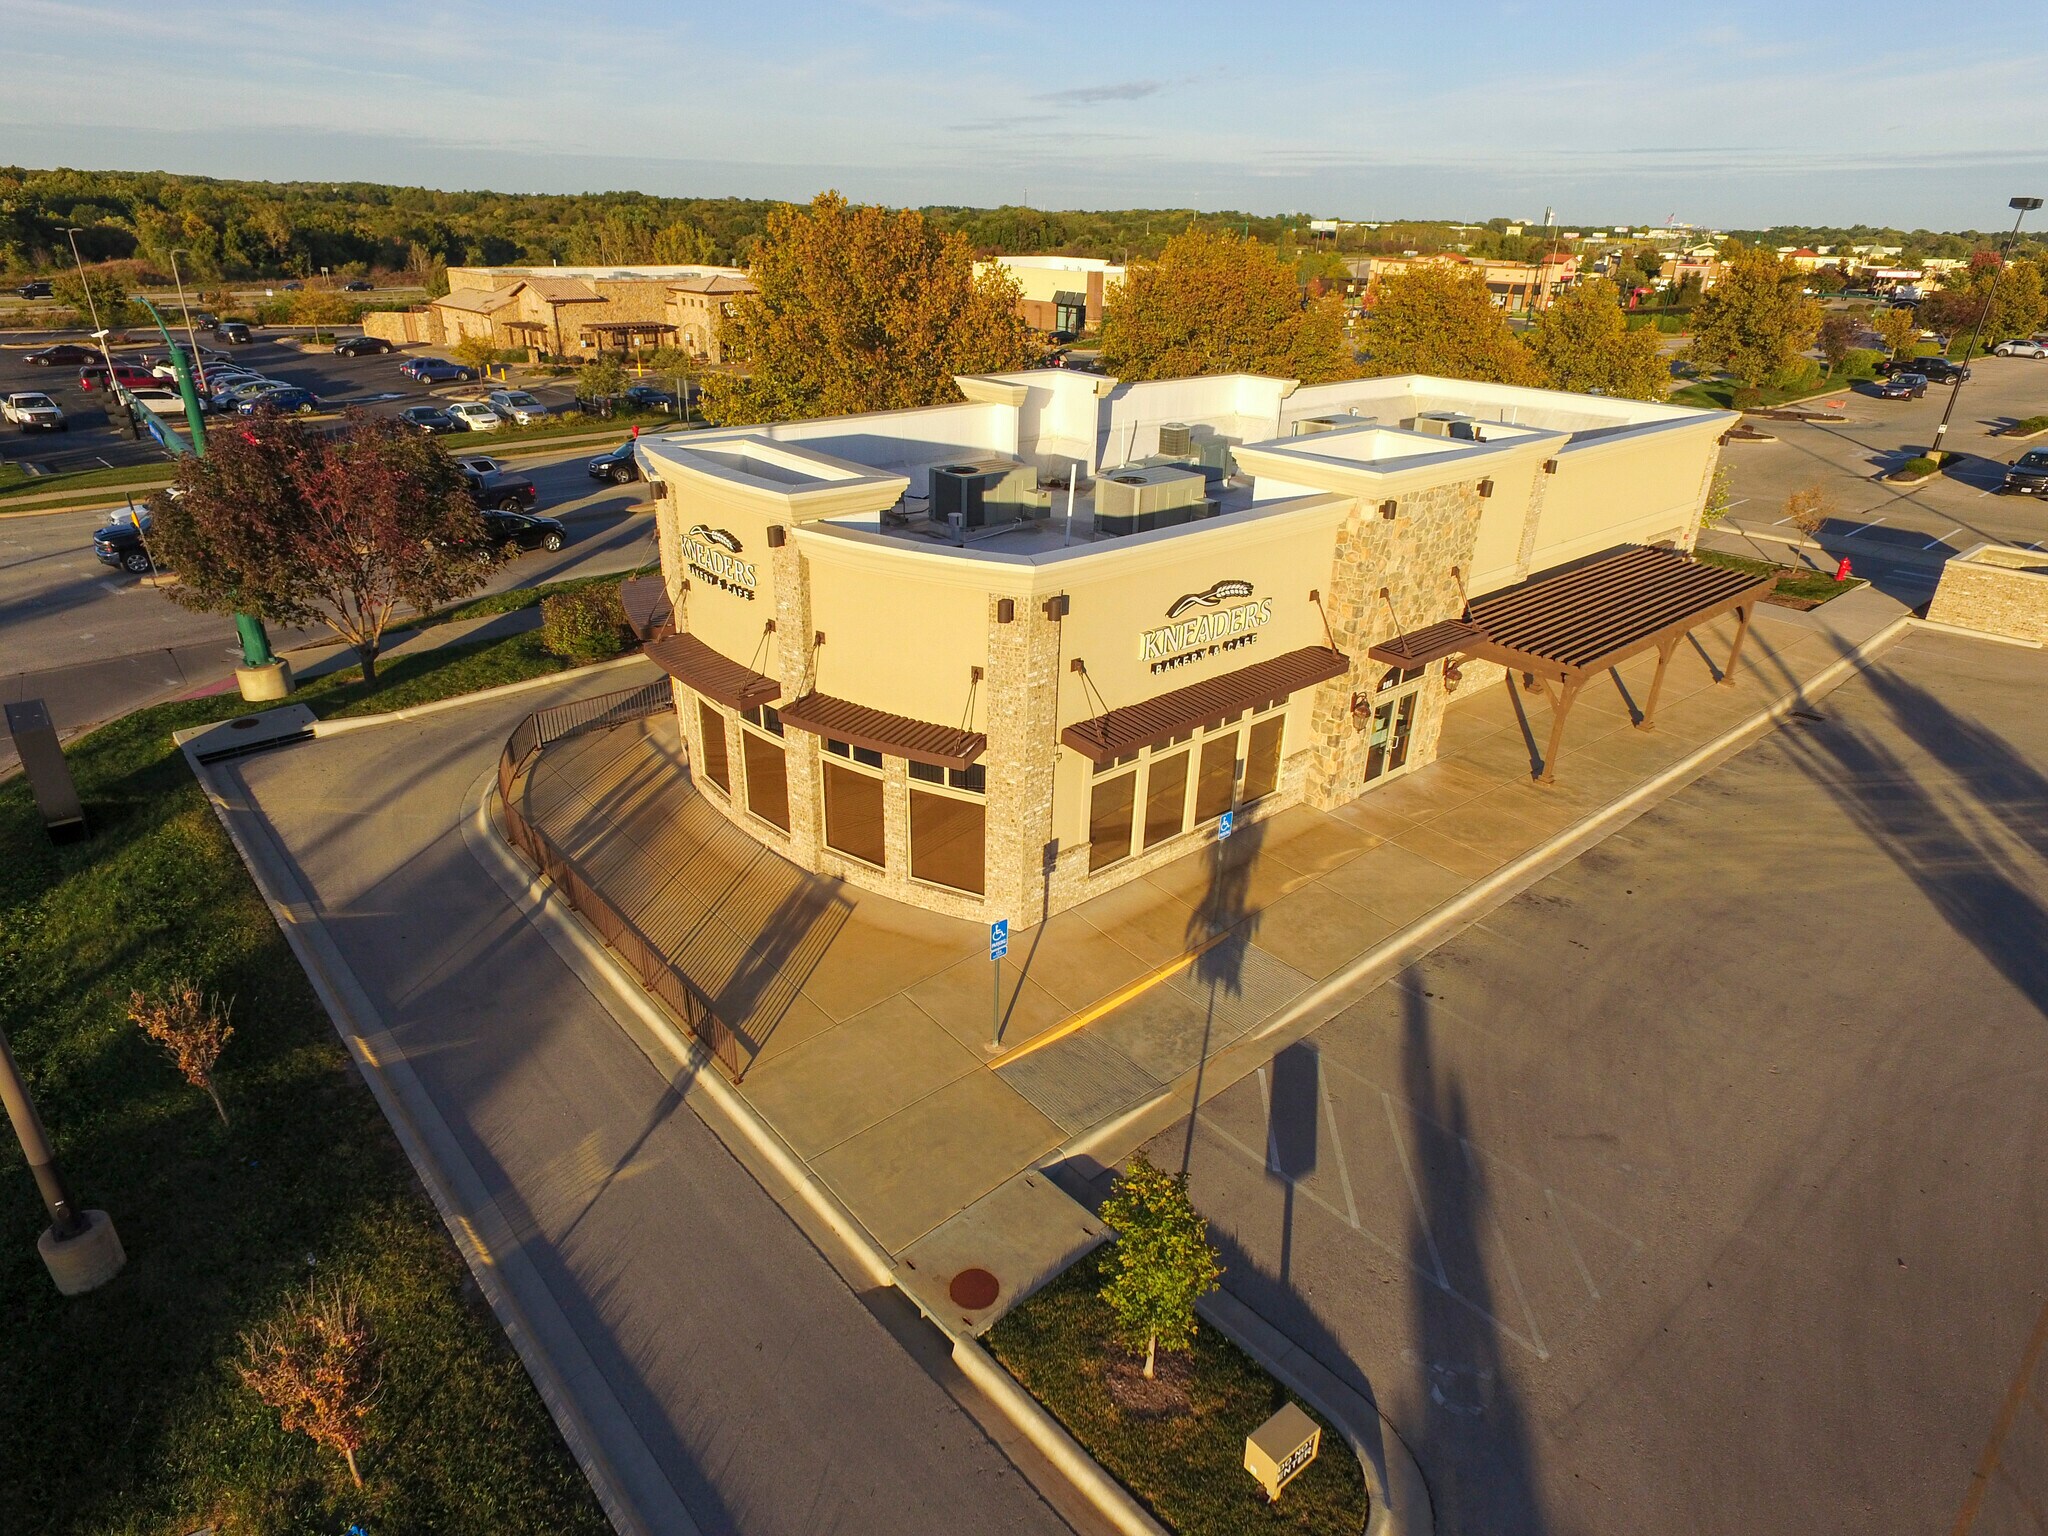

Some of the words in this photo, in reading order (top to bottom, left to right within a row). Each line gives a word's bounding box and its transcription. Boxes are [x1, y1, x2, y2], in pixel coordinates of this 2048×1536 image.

[680, 534, 757, 588] KNEADERS
[727, 584, 753, 601] CAFE
[1138, 597, 1273, 663] KNEADERS
[1152, 650, 1206, 676] BAKERY
[1226, 633, 1258, 652] CAFE
[1277, 1446, 1313, 1482] ENTER
[1278, 1456, 1293, 1474] DO
[1295, 1436, 1314, 1459] NOT
